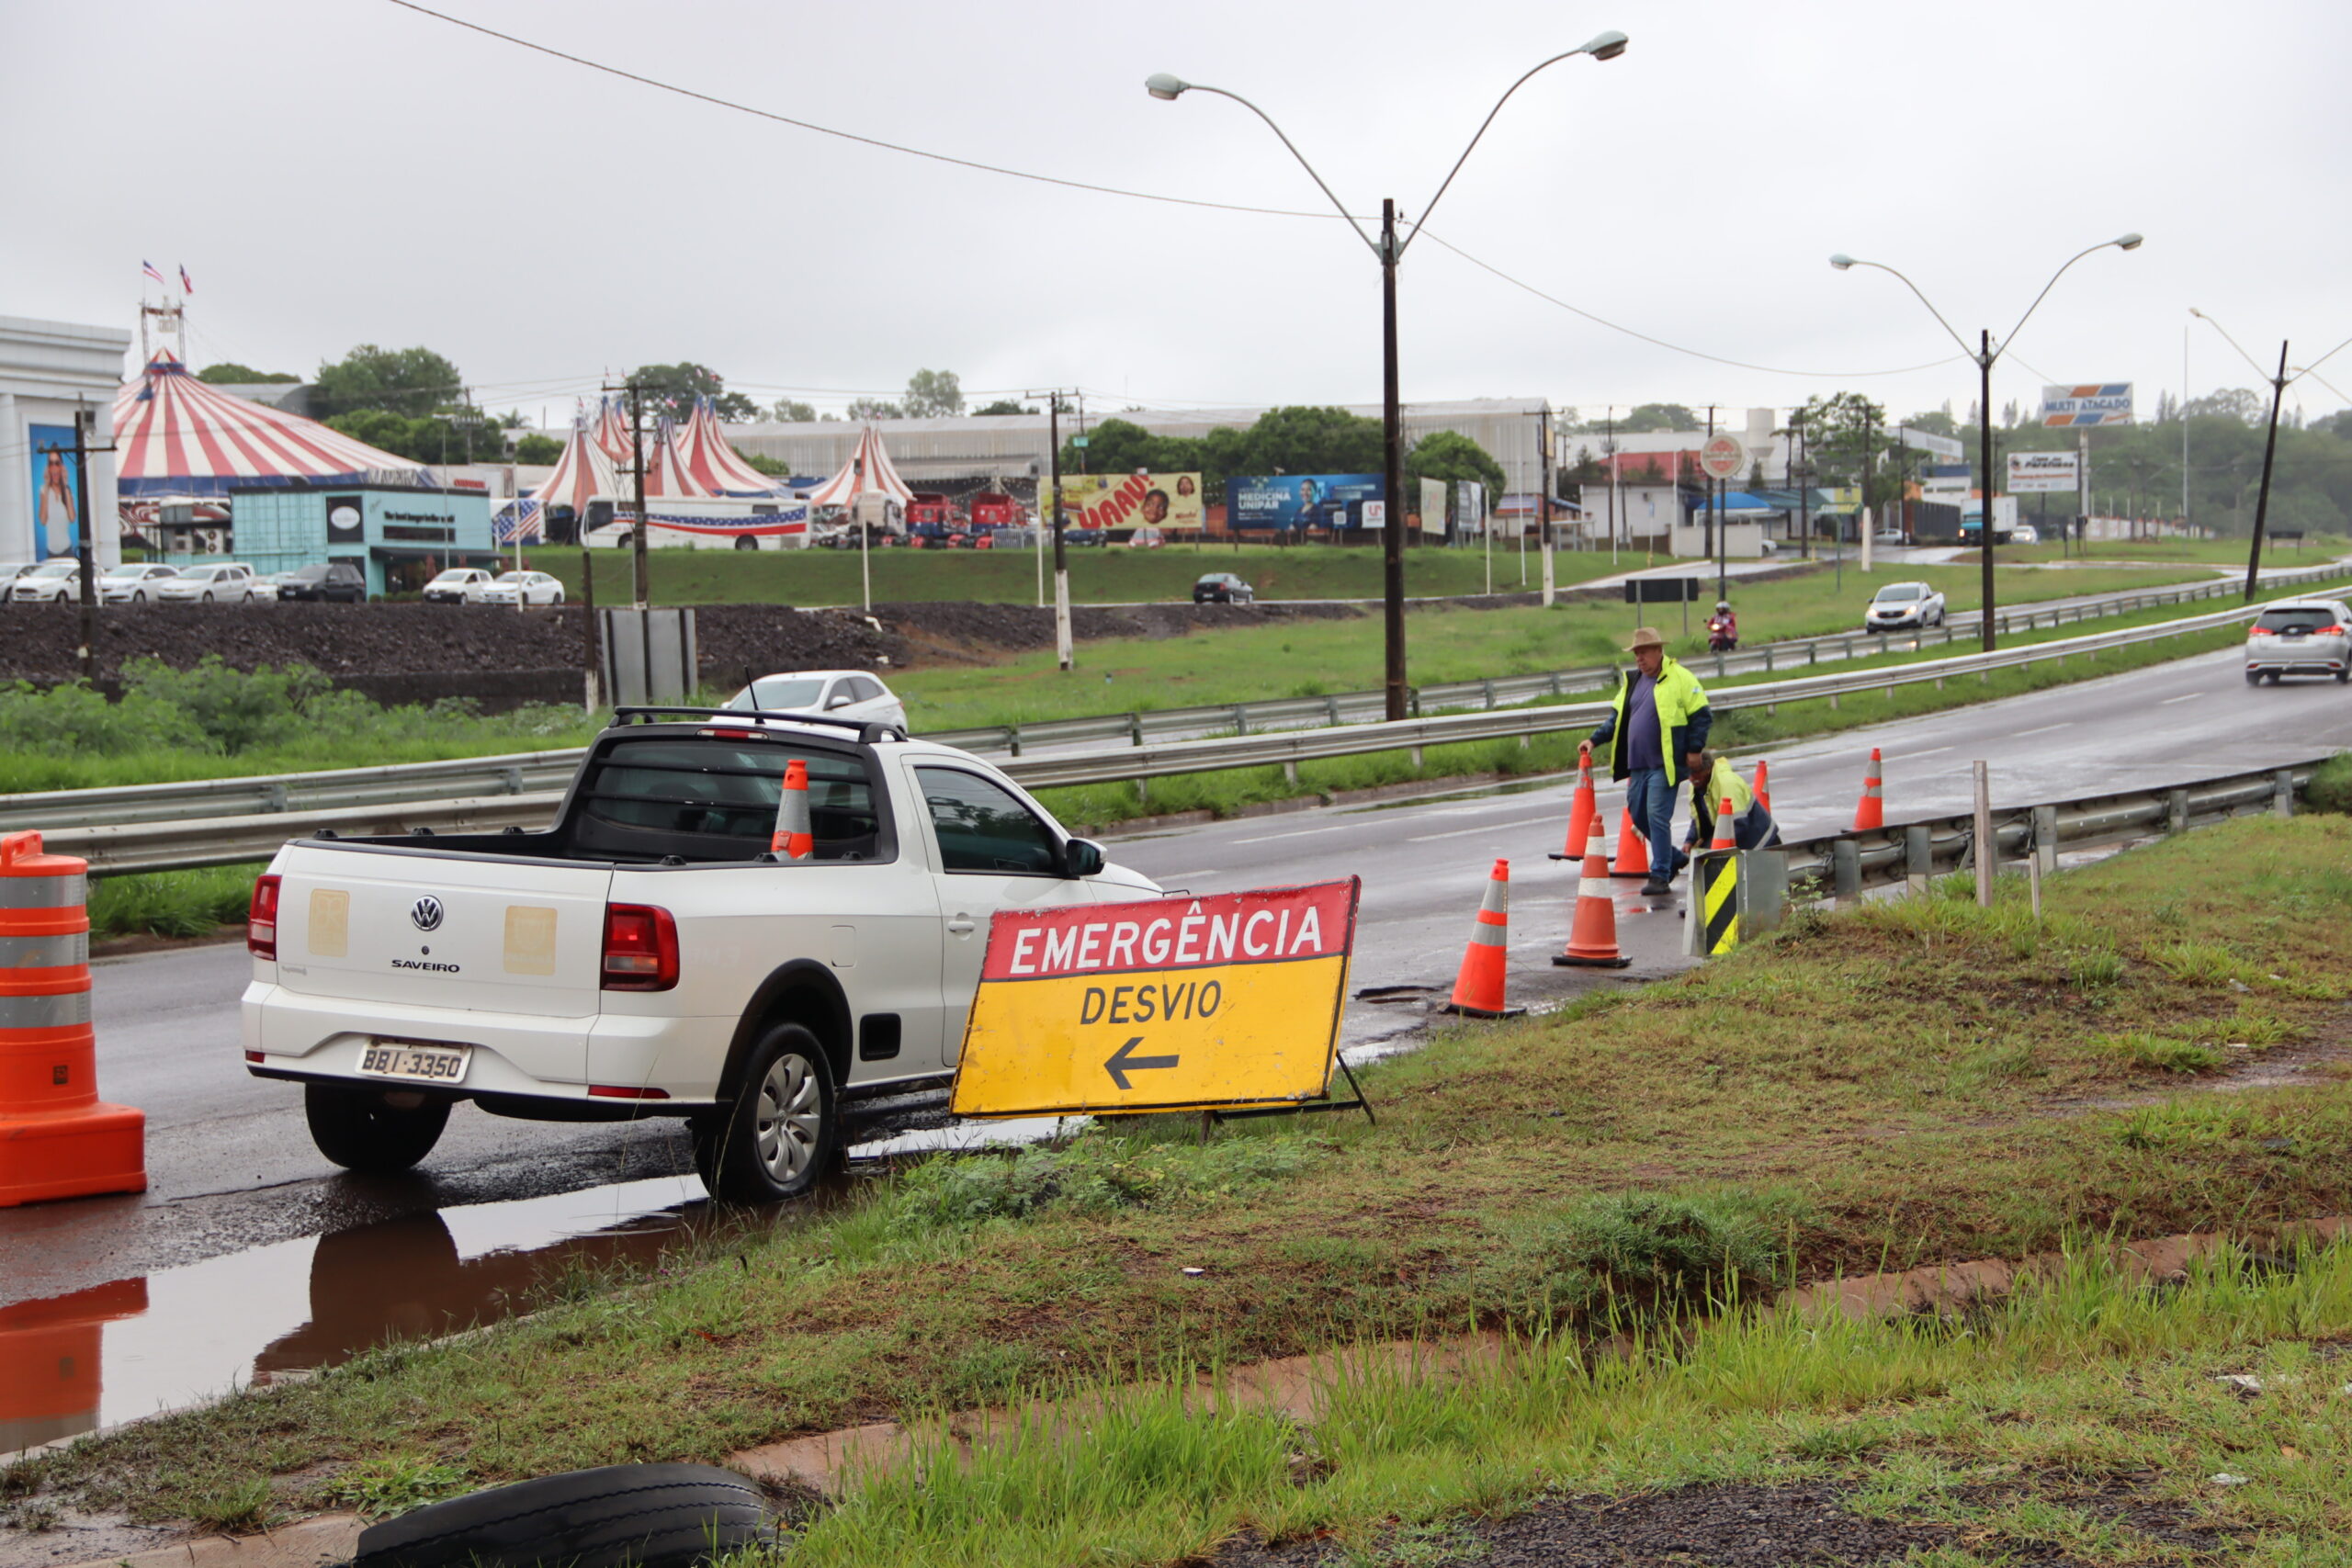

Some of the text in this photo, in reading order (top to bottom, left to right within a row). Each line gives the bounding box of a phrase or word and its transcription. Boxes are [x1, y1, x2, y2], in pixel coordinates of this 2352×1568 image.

[2044, 398, 2130, 412] MULTI ATACADO
[1238, 492, 1292, 502] MEDICINA
[1238, 501, 1279, 510] UNIPAR
[1010, 900, 1322, 975] EMERGÊNCIA
[391, 959, 460, 973] SAVEIRO
[1080, 979, 1222, 1025] DESVIO
